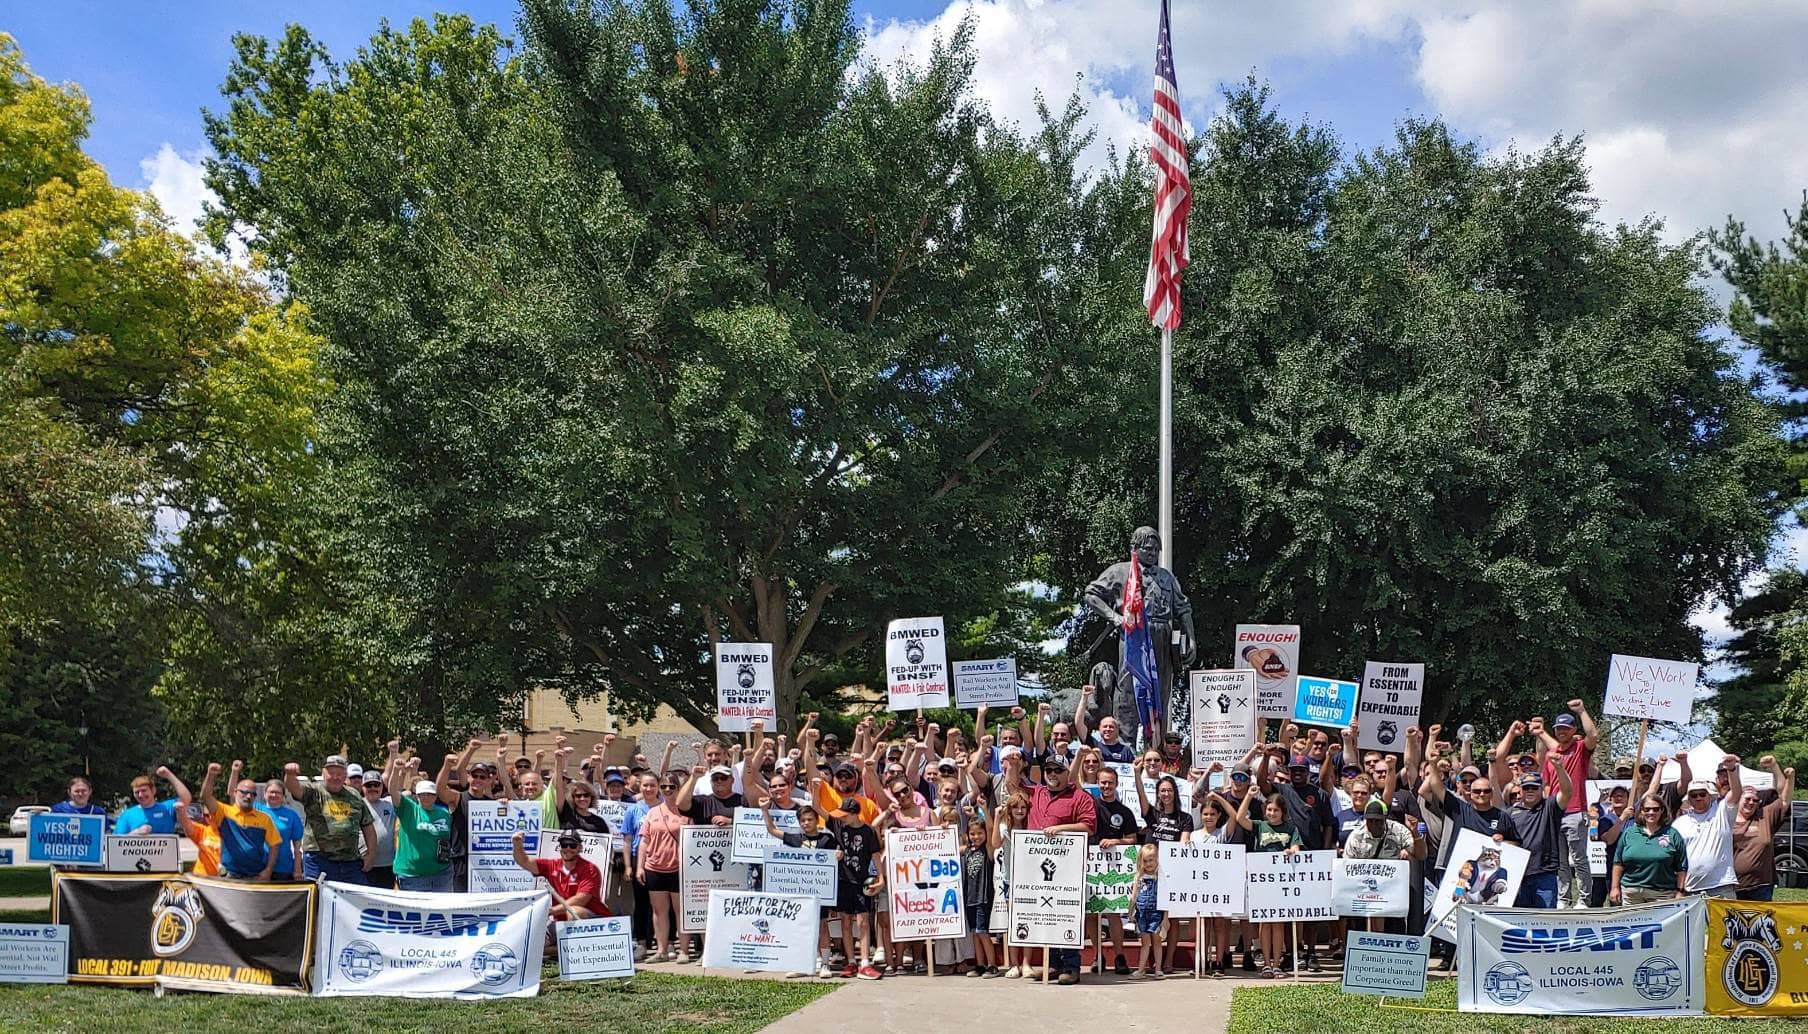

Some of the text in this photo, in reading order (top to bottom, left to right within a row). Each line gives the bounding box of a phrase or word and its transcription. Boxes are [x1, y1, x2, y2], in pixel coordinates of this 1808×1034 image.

[890, 628, 939, 640] BMWED
[1239, 633, 1296, 642] ENOUGH!
[721, 654, 768, 662] BMWED
[892, 666, 919, 674] FED-UP
[1382, 667, 1409, 678] FROM
[1614, 660, 1687, 686] We Work
[897, 672, 937, 681] BNSF
[1201, 675, 1234, 683] ENOUGH
[1206, 684, 1242, 692] ENOUGH!
[1370, 678, 1418, 690] ESSENTIAL
[1309, 685, 1326, 698] YES
[1304, 695, 1346, 710] WORKERS
[1386, 692, 1398, 703] TO
[1611, 695, 1672, 708] We Live
[1307, 705, 1344, 720] RIGHTS!
[1361, 702, 1419, 717] EXPENDABLE
[44, 822, 64, 832] YES
[38, 834, 92, 845] WORKERS
[899, 834, 936, 842] ENOUGH
[1024, 837, 1063, 846] ENOUGH
[44, 844, 88, 856] RIGHTS!
[904, 843, 942, 852] ENOUGH!
[1028, 848, 1070, 856] ENOUGH!
[773, 852, 814, 860] SMART
[1088, 852, 1122, 862] CORD
[1170, 848, 1232, 860] ENOUGH
[1272, 854, 1312, 864] FROM
[896, 858, 923, 884] MY
[1372, 870, 1394, 878] CREWS
[1383, 865, 1396, 873] TWO
[770, 876, 800, 884] Essential,
[1192, 870, 1209, 880] IS
[1250, 872, 1332, 882] ESSENTIAL
[778, 885, 821, 895] Street Profits.
[1090, 886, 1134, 895] ILLION
[1282, 888, 1300, 896] TO
[895, 888, 958, 914] Needs A
[1170, 892, 1230, 904] ENOUGH
[724, 896, 802, 912] FIGHT FOR TWO
[724, 906, 797, 920] PERSON CREWS
[357, 908, 508, 937] SMART
[896, 916, 960, 927] FAIR CONTRACT
[566, 924, 606, 934] SMART
[740, 934, 752, 942] WE
[1358, 937, 1403, 948] SMART
[1500, 924, 1662, 954] SMART
[43, 945, 57, 953] Are
[400, 948, 458, 958] LOCAL 445
[562, 946, 575, 954] We
[577, 944, 590, 953] Are
[568, 954, 626, 966] Not Expendable
[1362, 954, 1386, 964] Family
[390, 960, 462, 969] ILLINOIS-IOWA
[78, 958, 109, 976] LOCAL
[110, 960, 132, 976] 391
[234, 967, 272, 985] IOWA
[1350, 964, 1422, 978] important than their
[1550, 966, 1614, 976] LOCAL 445
[1355, 974, 1415, 987] Corporate Greed
[1540, 978, 1624, 988] ILLINOIS-IOWA
